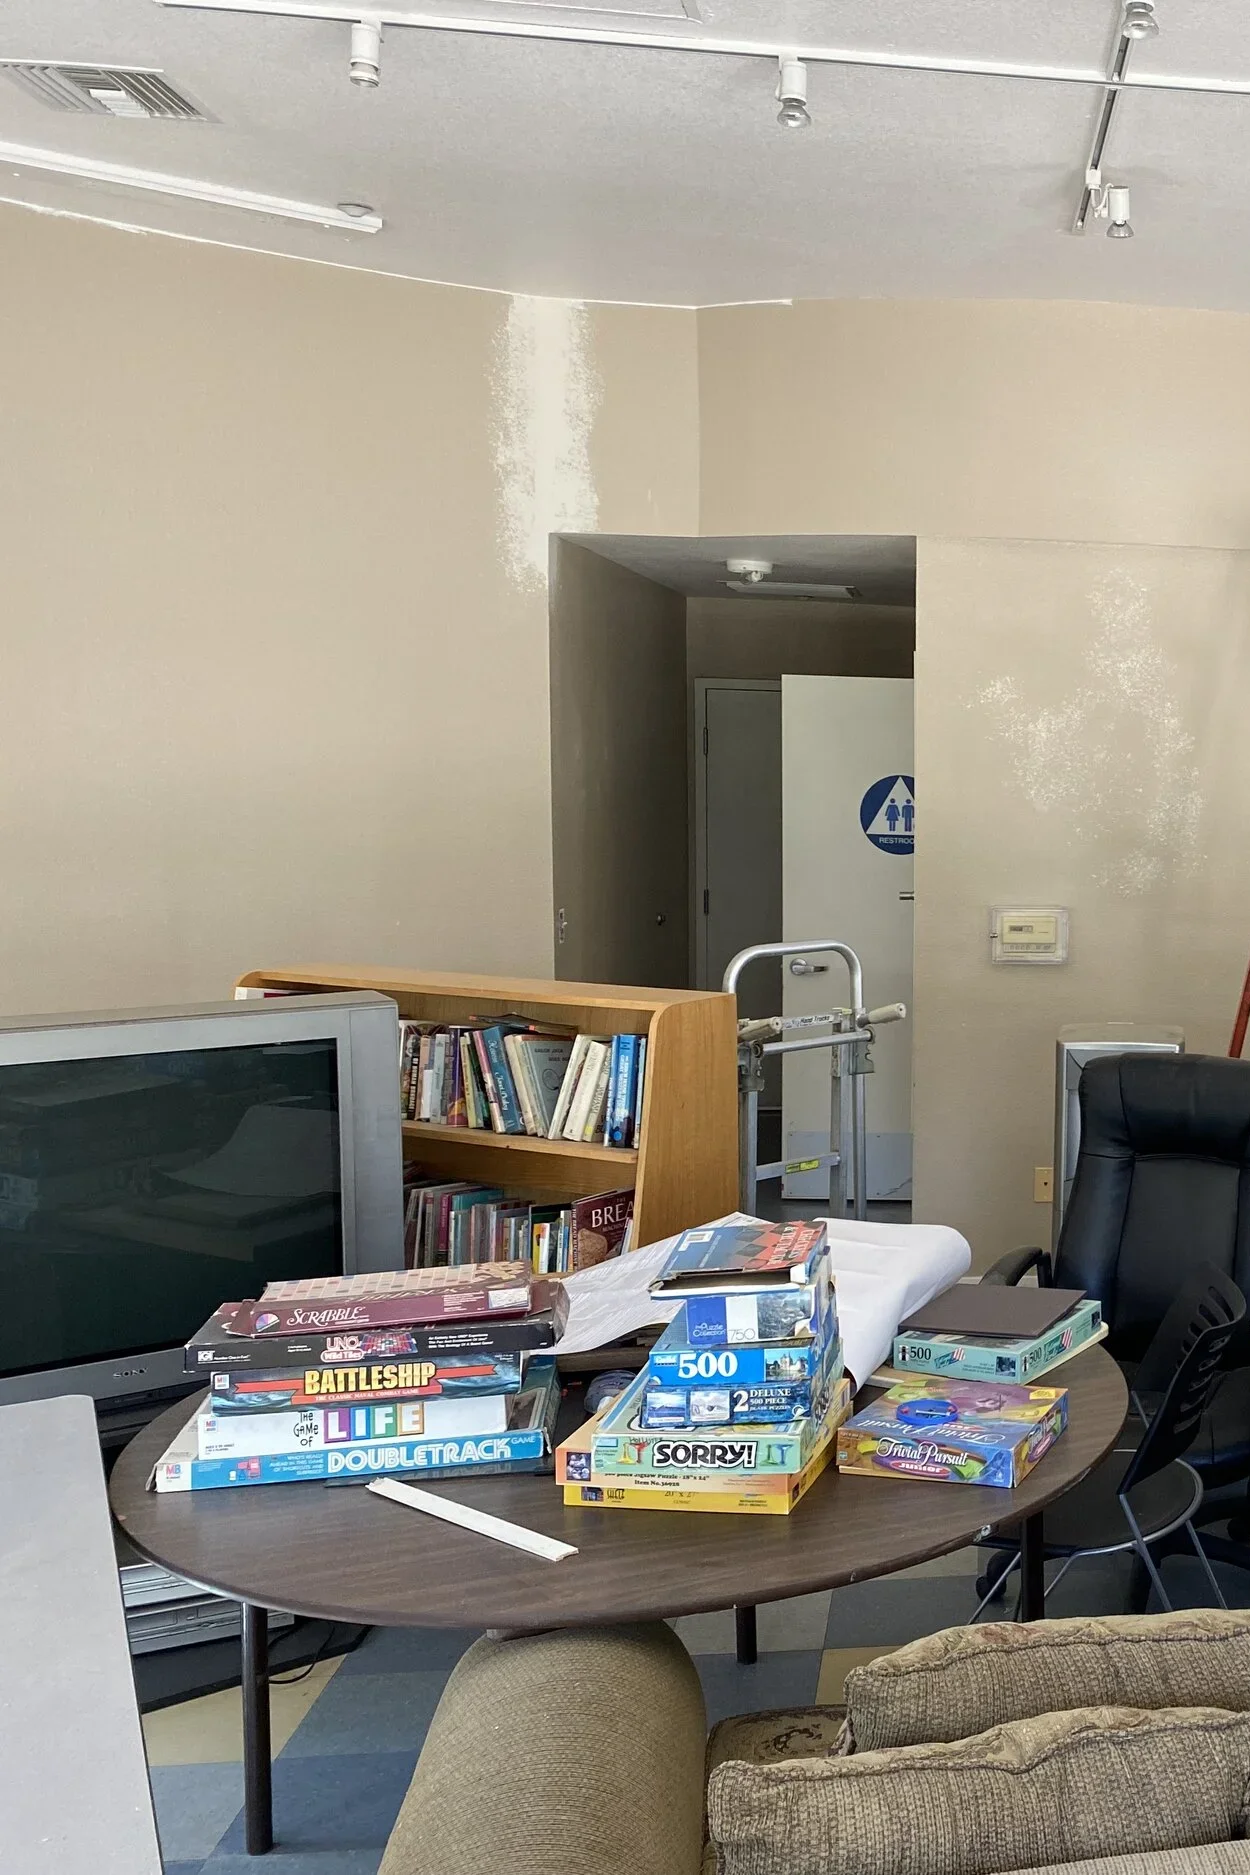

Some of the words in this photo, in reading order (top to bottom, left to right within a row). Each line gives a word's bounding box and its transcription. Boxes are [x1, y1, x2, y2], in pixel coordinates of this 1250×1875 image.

[879, 837, 914, 845] RESTROO
[591, 1200, 634, 1228] BREA
[286, 1306, 365, 1327] SCRABBLE
[326, 1335, 359, 1350] UNO
[728, 1328, 756, 1341] 750
[678, 1351, 738, 1379] 500
[909, 1346, 931, 1361] 500
[304, 1362, 436, 1395] BATTLESHIP
[732, 1389, 749, 1412] 2
[750, 1388, 791, 1397] DELUXE
[326, 1404, 421, 1440] LIFE
[327, 1437, 511, 1473] DOUBLETRACK
[511, 1435, 536, 1444] GAME
[654, 1442, 756, 1467] SORRY!
[876, 1437, 922, 1459] Trivial
[919, 1441, 969, 1466] Pursuit
[165, 1464, 181, 1475] MB
